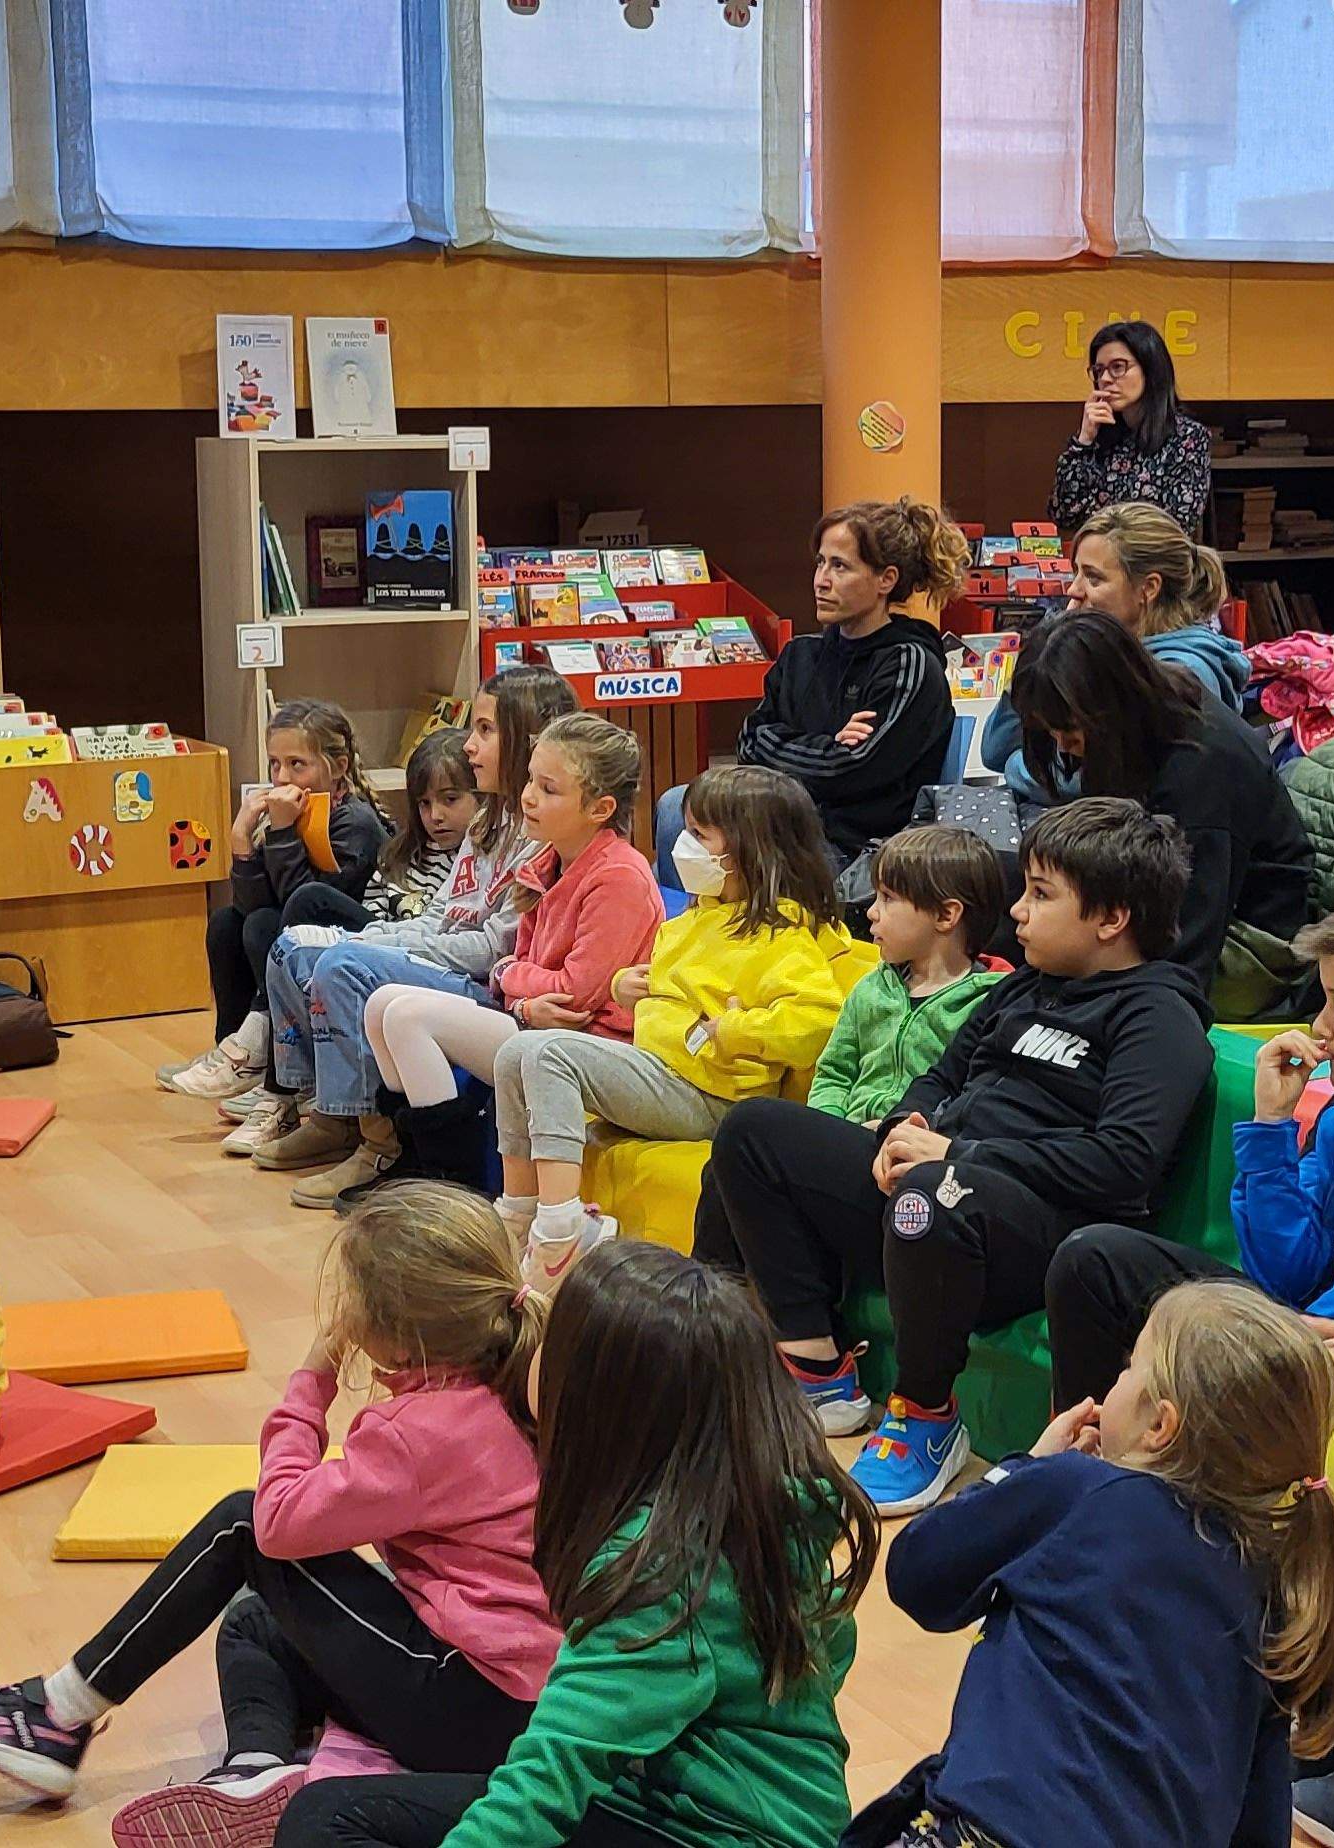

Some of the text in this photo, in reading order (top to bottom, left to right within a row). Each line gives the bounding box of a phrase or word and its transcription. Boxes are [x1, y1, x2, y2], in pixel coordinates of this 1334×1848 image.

[1003, 310, 1199, 359] CIE
[1030, 526, 1040, 536] B
[606, 533, 639, 546] 17331
[375, 588, 446, 597] LOS TRES BANDIDOS
[979, 581, 989, 593] H
[1038, 583, 1045, 594] I
[252, 646, 264, 661] 2
[598, 674, 679, 696] MÚSICA
[1011, 1023, 1090, 1069] NIKE
